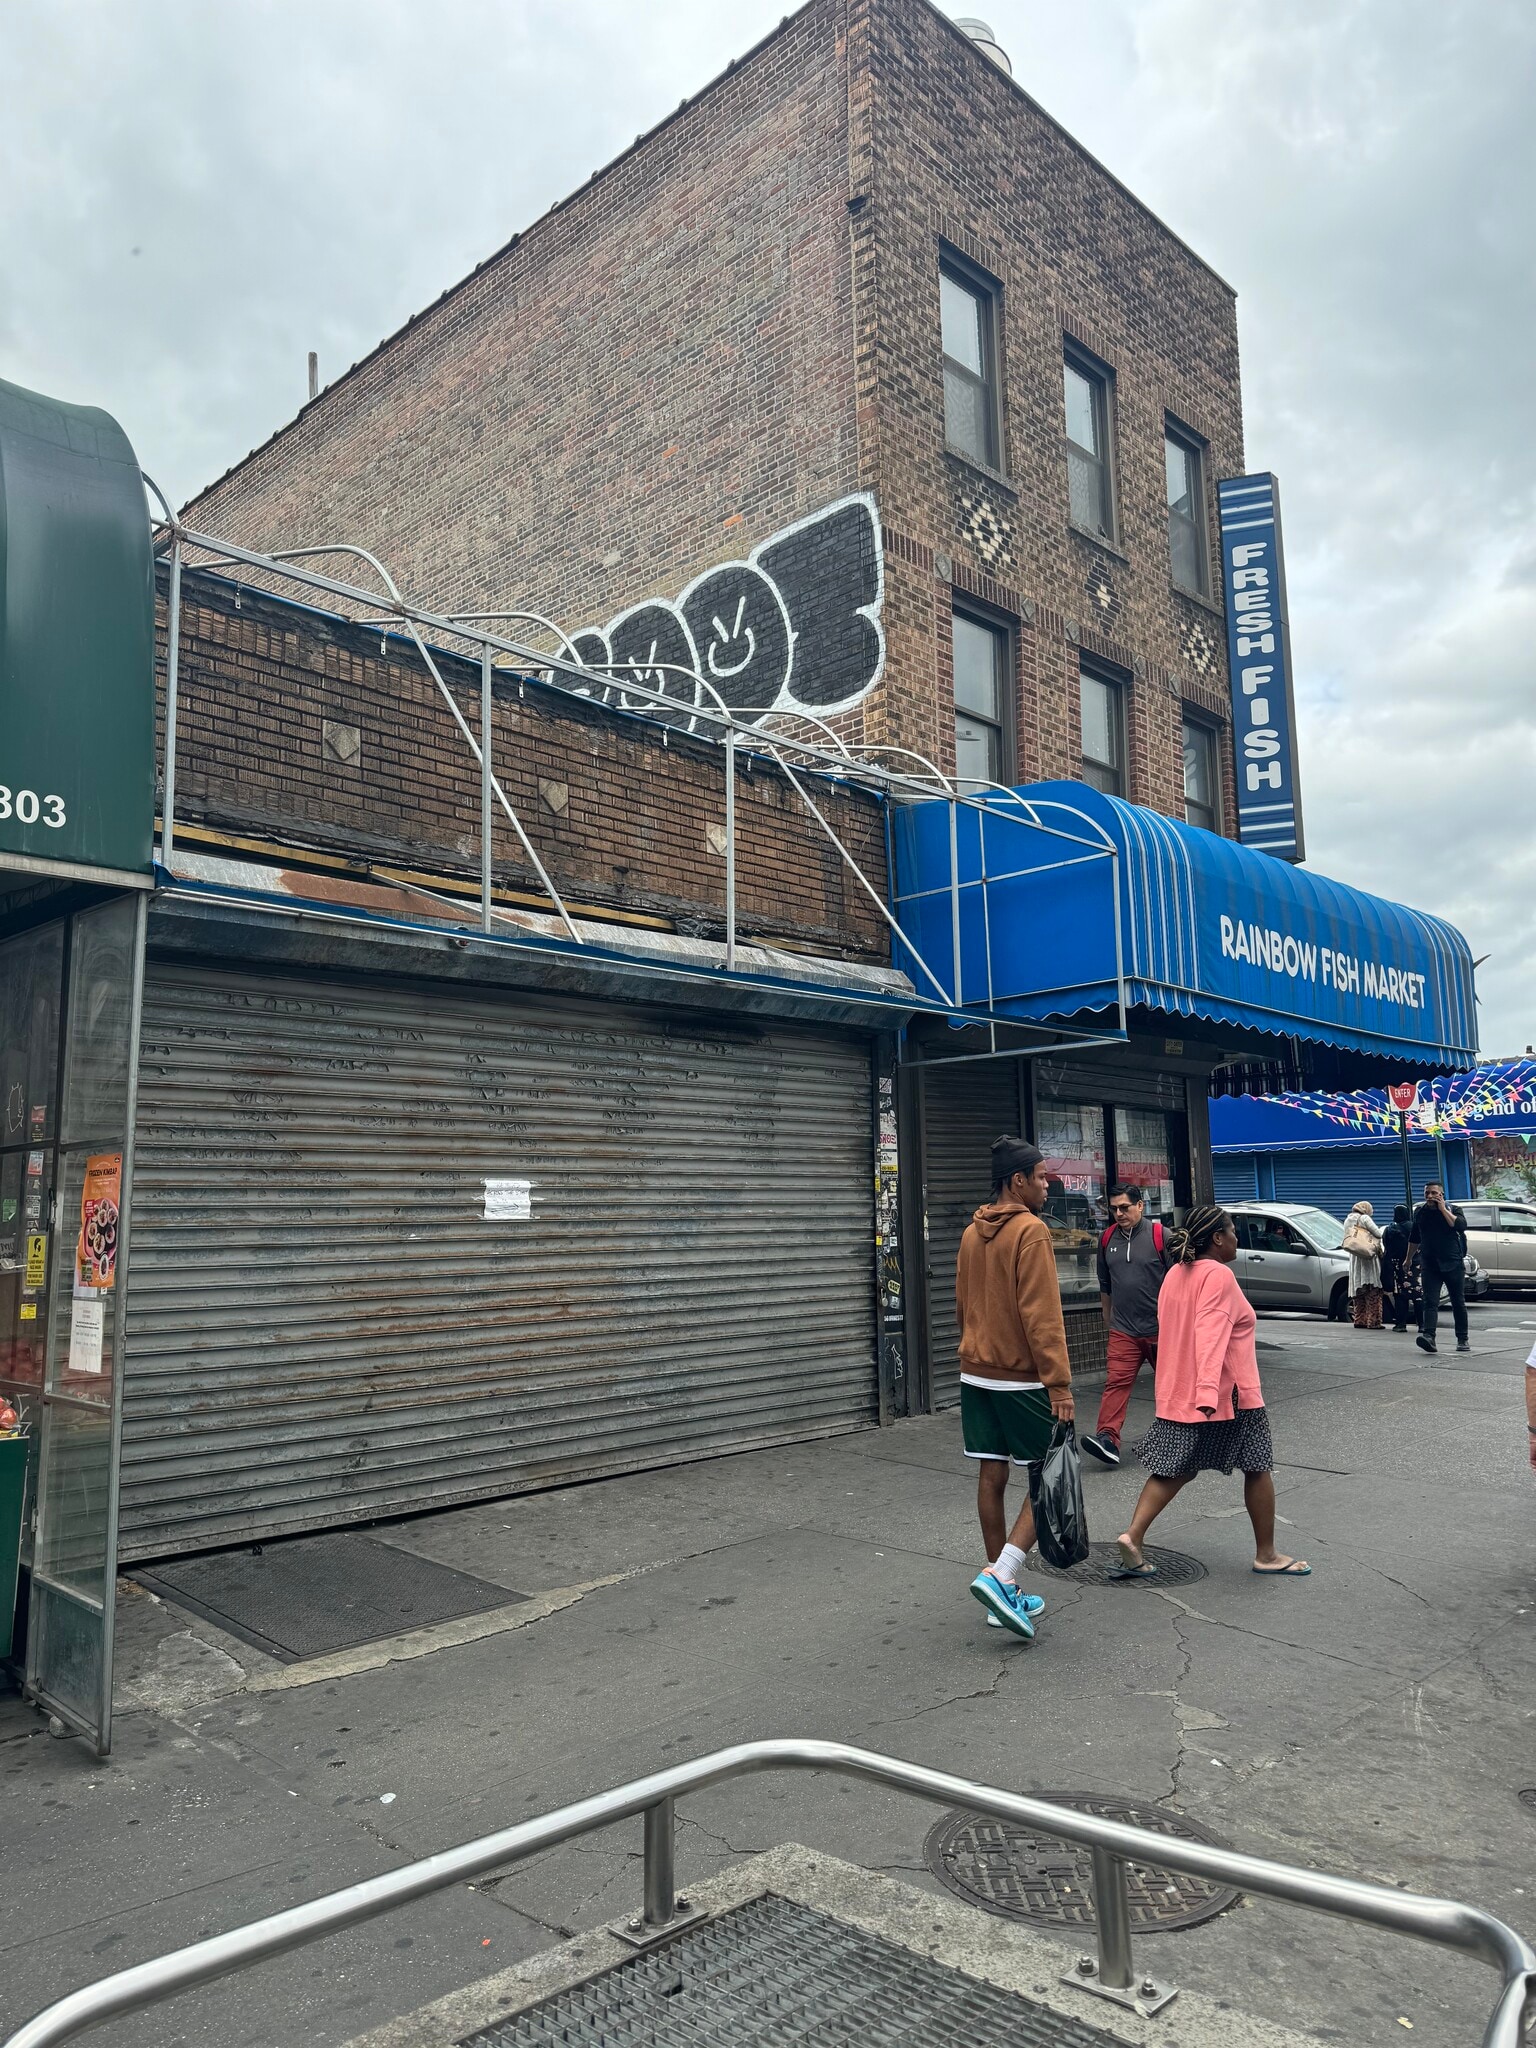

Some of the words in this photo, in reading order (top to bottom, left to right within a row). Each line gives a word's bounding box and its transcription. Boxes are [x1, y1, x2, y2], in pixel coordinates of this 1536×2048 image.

[1232, 542, 1275, 657] FRESH
[1241, 665, 1282, 791] FISH
[1220, 914, 1317, 983] RAINBOW
[1321, 947, 1360, 995] FISH
[1363, 960, 1425, 1009] MARKET
[1394, 1088, 1411, 1098] ENTER
